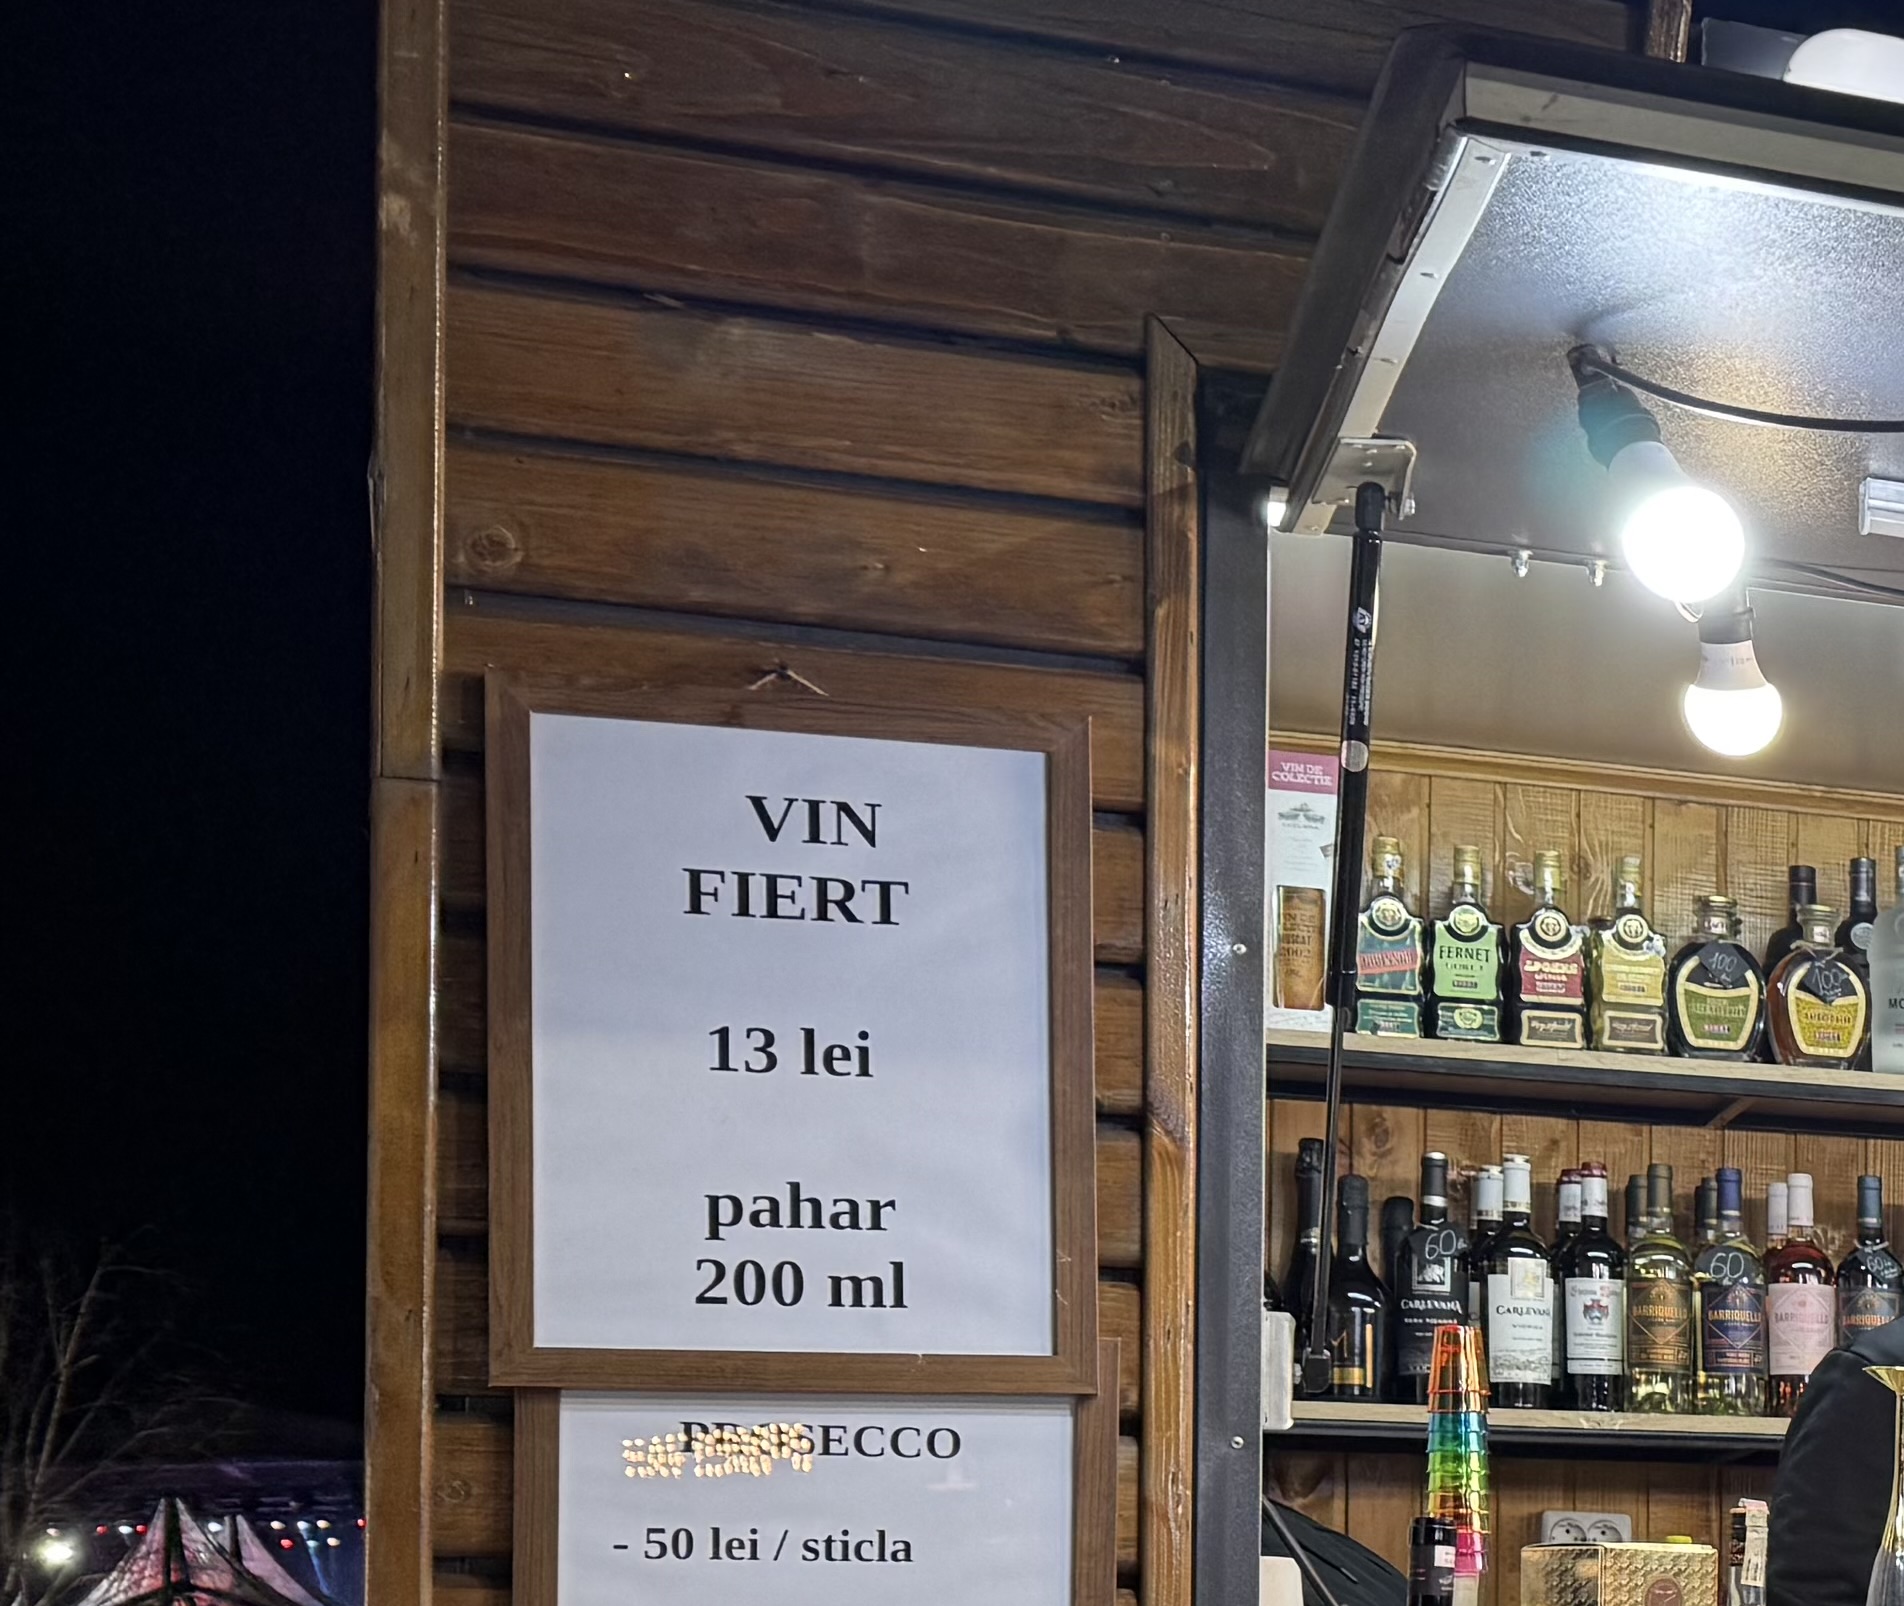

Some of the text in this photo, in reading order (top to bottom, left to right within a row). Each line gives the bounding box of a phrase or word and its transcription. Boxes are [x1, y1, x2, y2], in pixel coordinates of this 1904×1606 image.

[744, 795, 883, 849] VIN
[681, 867, 910, 926] FIERT
[1439, 946, 1490, 963] FERNET
[708, 1025, 874, 1078] 13 lei
[703, 1181, 897, 1242] pahar
[695, 1258, 909, 1309] 200 ml
[1710, 1251, 1744, 1279] 60
[644, 1526, 914, 1563] 50 lei sticla
